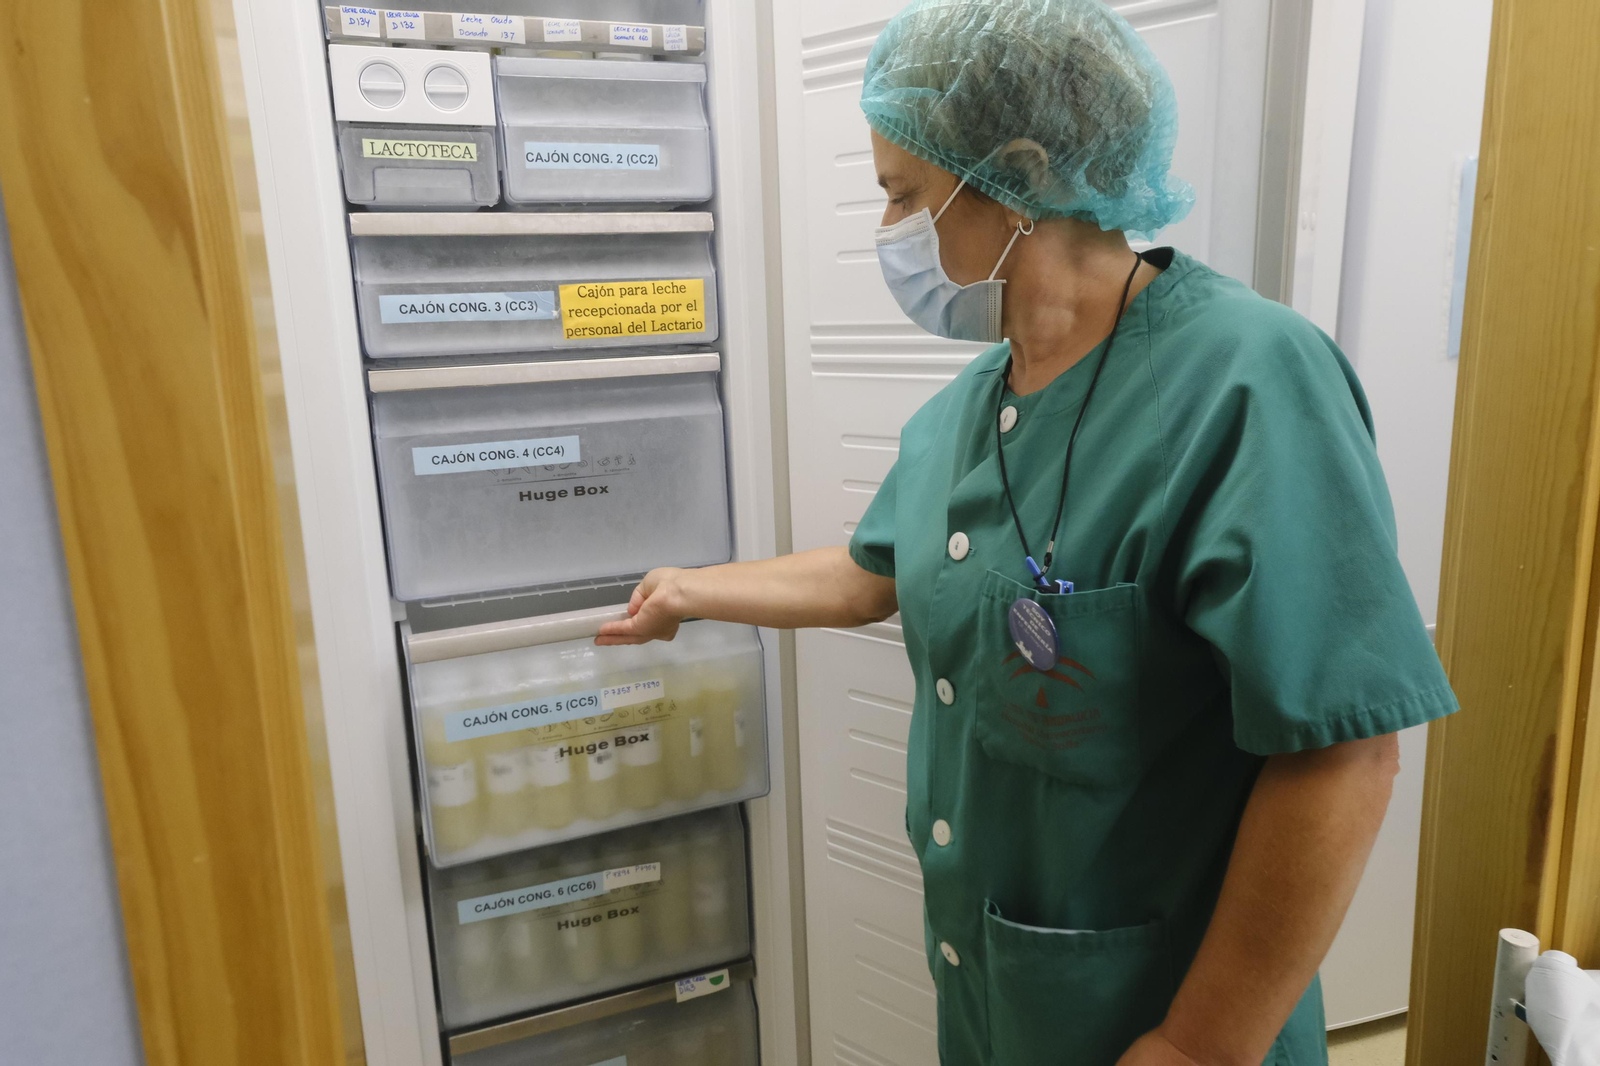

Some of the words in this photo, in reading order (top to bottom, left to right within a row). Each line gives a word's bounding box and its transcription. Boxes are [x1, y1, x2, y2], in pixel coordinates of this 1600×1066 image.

[460, 14, 483, 24] Leche
[501, 31, 515, 40] 137
[369, 141, 474, 159] LACTOTECA
[525, 150, 570, 163] CAJÓN
[573, 153, 613, 164] CONG.
[616, 154, 623, 164] 2
[626, 154, 658, 167] (CC2)
[577, 285, 615, 299] Cajón
[619, 286, 648, 298] para
[652, 282, 687, 295] leche
[399, 301, 445, 314] CAJÓN
[449, 302, 491, 313] CONG.
[494, 302, 502, 312] 3
[505, 300, 538, 314] (CC3)
[568, 303, 656, 318] recepcionada
[660, 303, 682, 315] por
[686, 300, 698, 312] el
[566, 322, 623, 338] personal
[627, 321, 647, 333] del
[651, 318, 703, 332] Lactario
[431, 451, 475, 465] CAJÓN
[478, 449, 519, 461] CONG.
[522, 448, 529, 458] 4
[533, 445, 565, 459] (CC4)
[518, 489, 568, 502] Huge
[574, 485, 609, 497] Box
[463, 711, 508, 728] CAJÓN
[511, 705, 552, 720] CONG.
[556, 702, 563, 711] 5
[566, 696, 598, 711] (CC5)
[559, 740, 609, 757] Huge
[615, 733, 650, 747] Box
[474, 898, 515, 913] CAJÓN
[518, 890, 555, 904] CONG.
[558, 887, 564, 896] 6
[567, 880, 596, 895] (CC6)
[557, 914, 602, 931] Huge
[607, 906, 640, 919] Box
